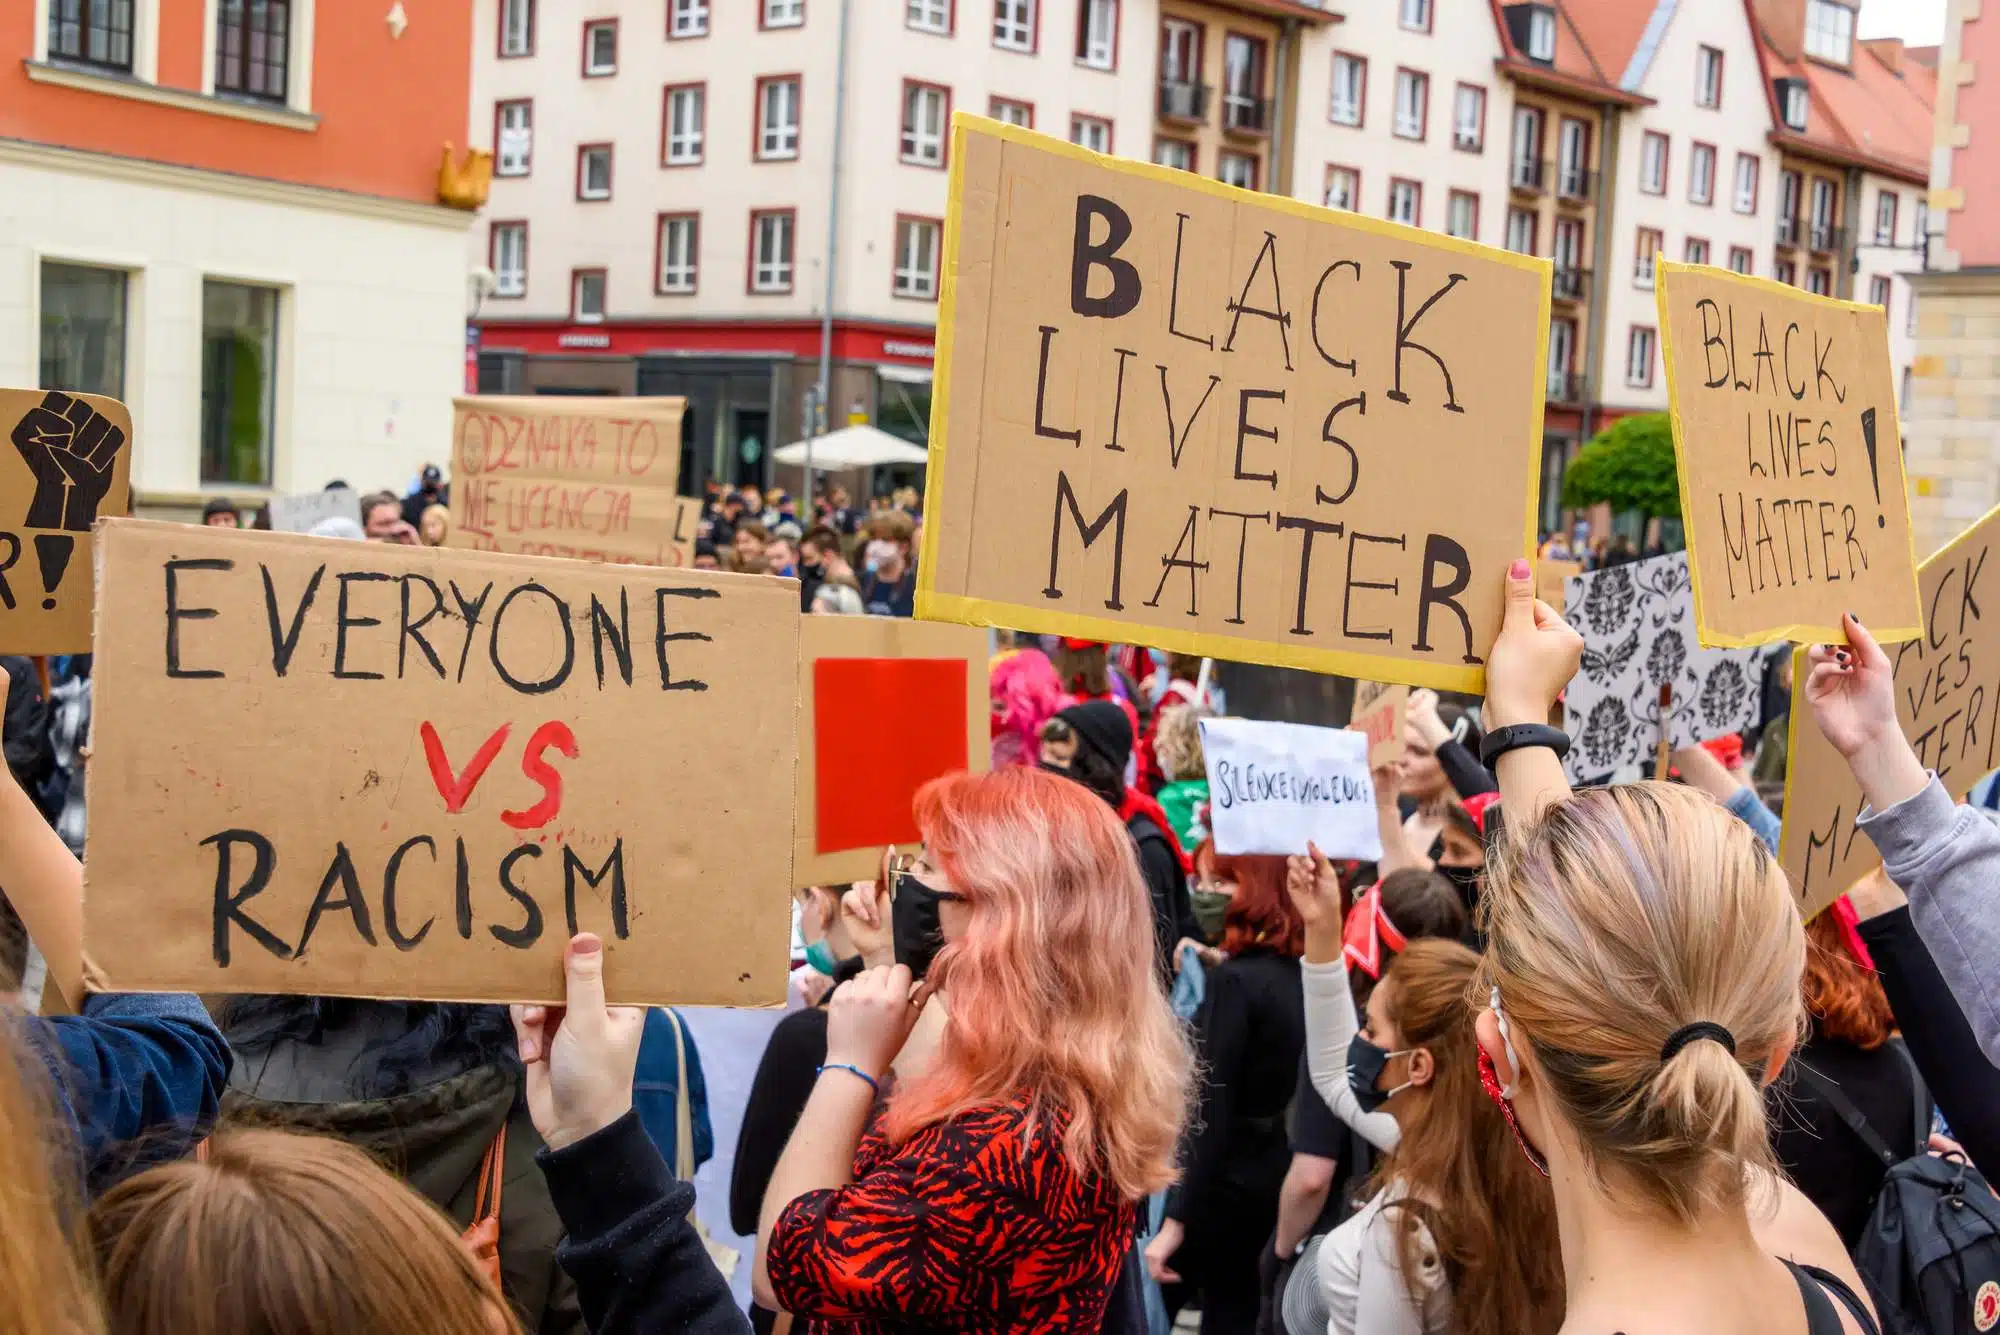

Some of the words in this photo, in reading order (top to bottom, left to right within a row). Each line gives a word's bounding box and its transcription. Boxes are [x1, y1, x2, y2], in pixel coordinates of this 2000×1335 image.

[1071, 194, 1467, 412] BLACK
[1696, 299, 1846, 403] BLACK
[460, 410, 598, 475] ODZNAKA
[608, 418, 659, 476] TO
[1034, 326, 1366, 504] LIVES
[1748, 409, 1837, 480] LIVES
[1042, 470, 1484, 663] MATTER
[1719, 492, 1868, 600] MATTER
[163, 556, 721, 695] EVERYONE
[1893, 546, 1988, 680] ACK
[1907, 638, 1973, 721] VES
[420, 720, 580, 830] VS
[199, 828, 631, 968] RACISM
